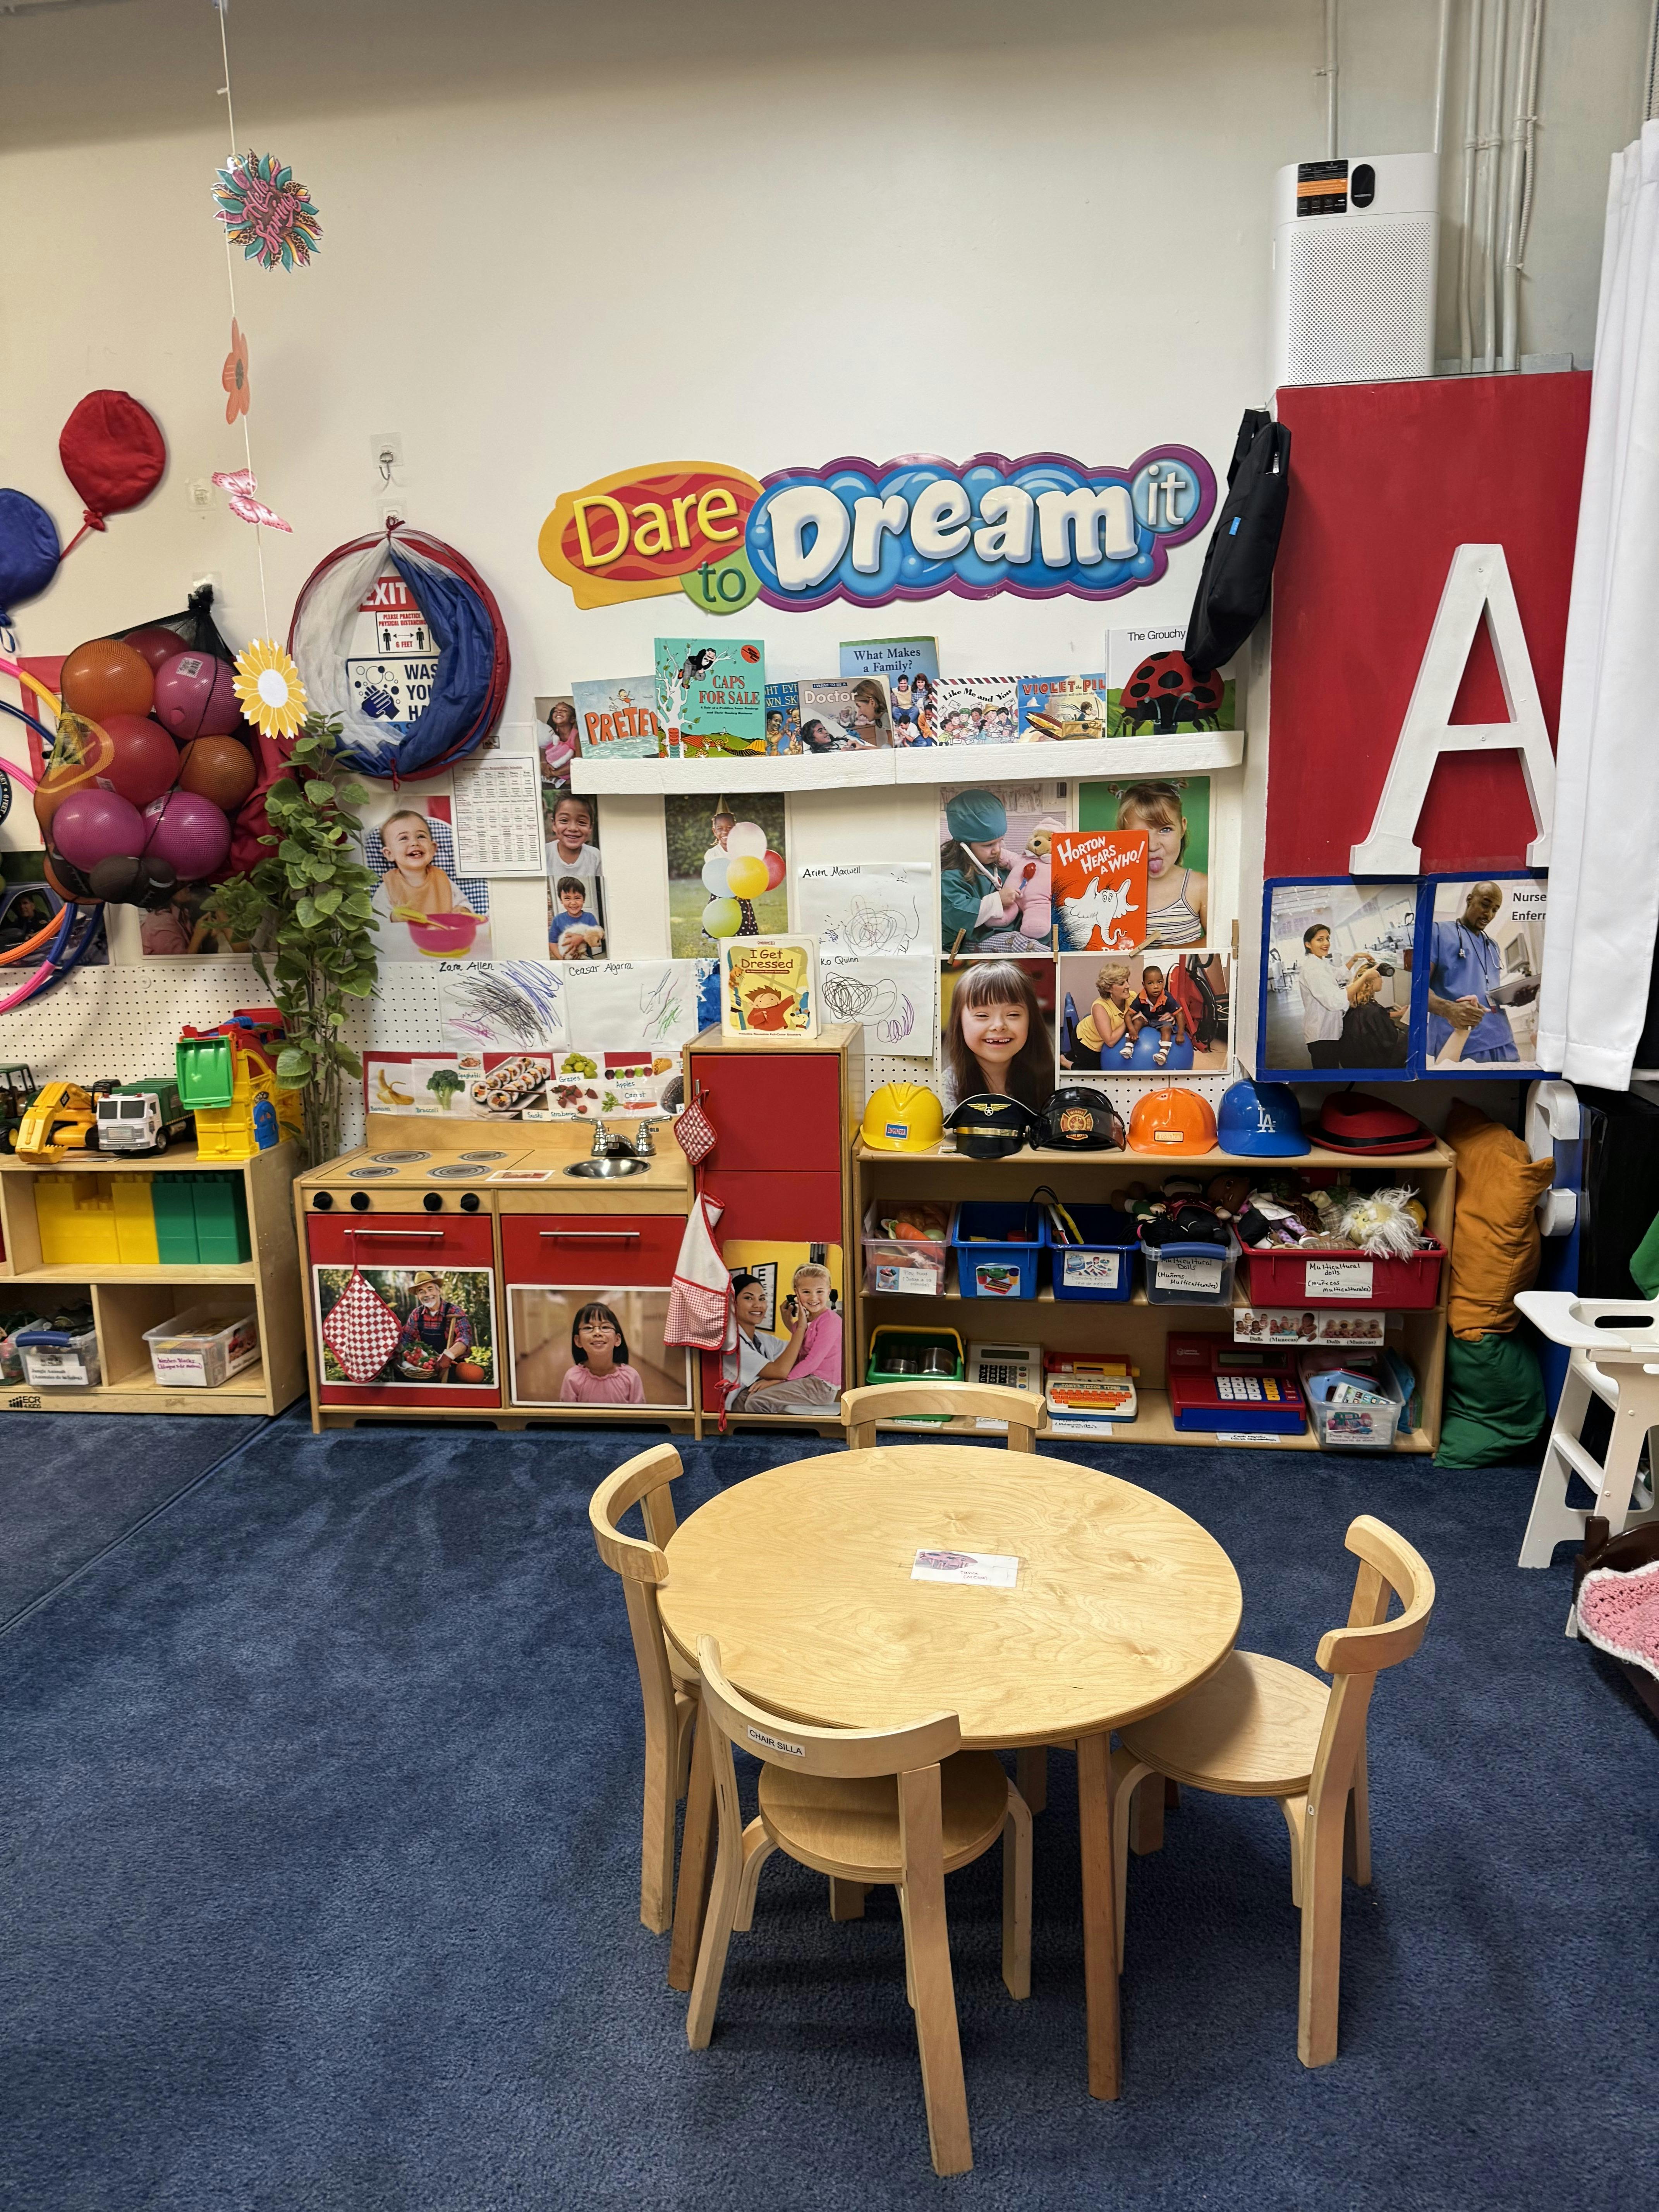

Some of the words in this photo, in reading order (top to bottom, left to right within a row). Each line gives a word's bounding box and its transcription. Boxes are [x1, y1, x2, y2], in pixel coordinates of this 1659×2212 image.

[574, 488, 740, 568] Dare
[697, 562, 746, 604] to
[768, 481, 1138, 591] Dream
[1146, 465, 1185, 526] it
[1127, 632, 1145, 641] The
[1147, 630, 1186, 641] Grouchy
[854, 651, 883, 660] What
[888, 647, 921, 658] Makes
[873, 660, 912, 672] Family?
[713, 675, 745, 689] CAPS
[1023, 681, 1075, 695] VIOLET
[699, 691, 725, 704] FOR
[728, 691, 760, 704] SALE
[804, 690, 858, 704] Doctor
[943, 690, 962, 701] Like
[964, 688, 976, 697] Me
[996, 690, 1012, 700] You
[1349, 544, 1556, 875] A
[1056, 836, 1106, 866] HORTON
[1080, 845, 1117, 874] HEARS
[1101, 865, 1108, 875] A
[1108, 841, 1146, 874] WHO!
[802, 869, 828, 878] Arien
[831, 866, 860, 876] Maxwell
[1513, 893, 1546, 902] Nurse
[750, 950, 757, 958] I
[760, 950, 783, 959] Get
[835, 956, 859, 965] Quinn
[467, 962, 494, 970] Allen
[570, 965, 600, 976] Ceasar
[604, 963, 634, 975] Algarra
[742, 958, 793, 968] Dressed
[1257, 1104, 1276, 1133] LA
[1161, 1258, 1212, 1266] Multicultural
[750, 1729, 775, 1747] CHAIR
[777, 1742, 802, 1755] SILLA
